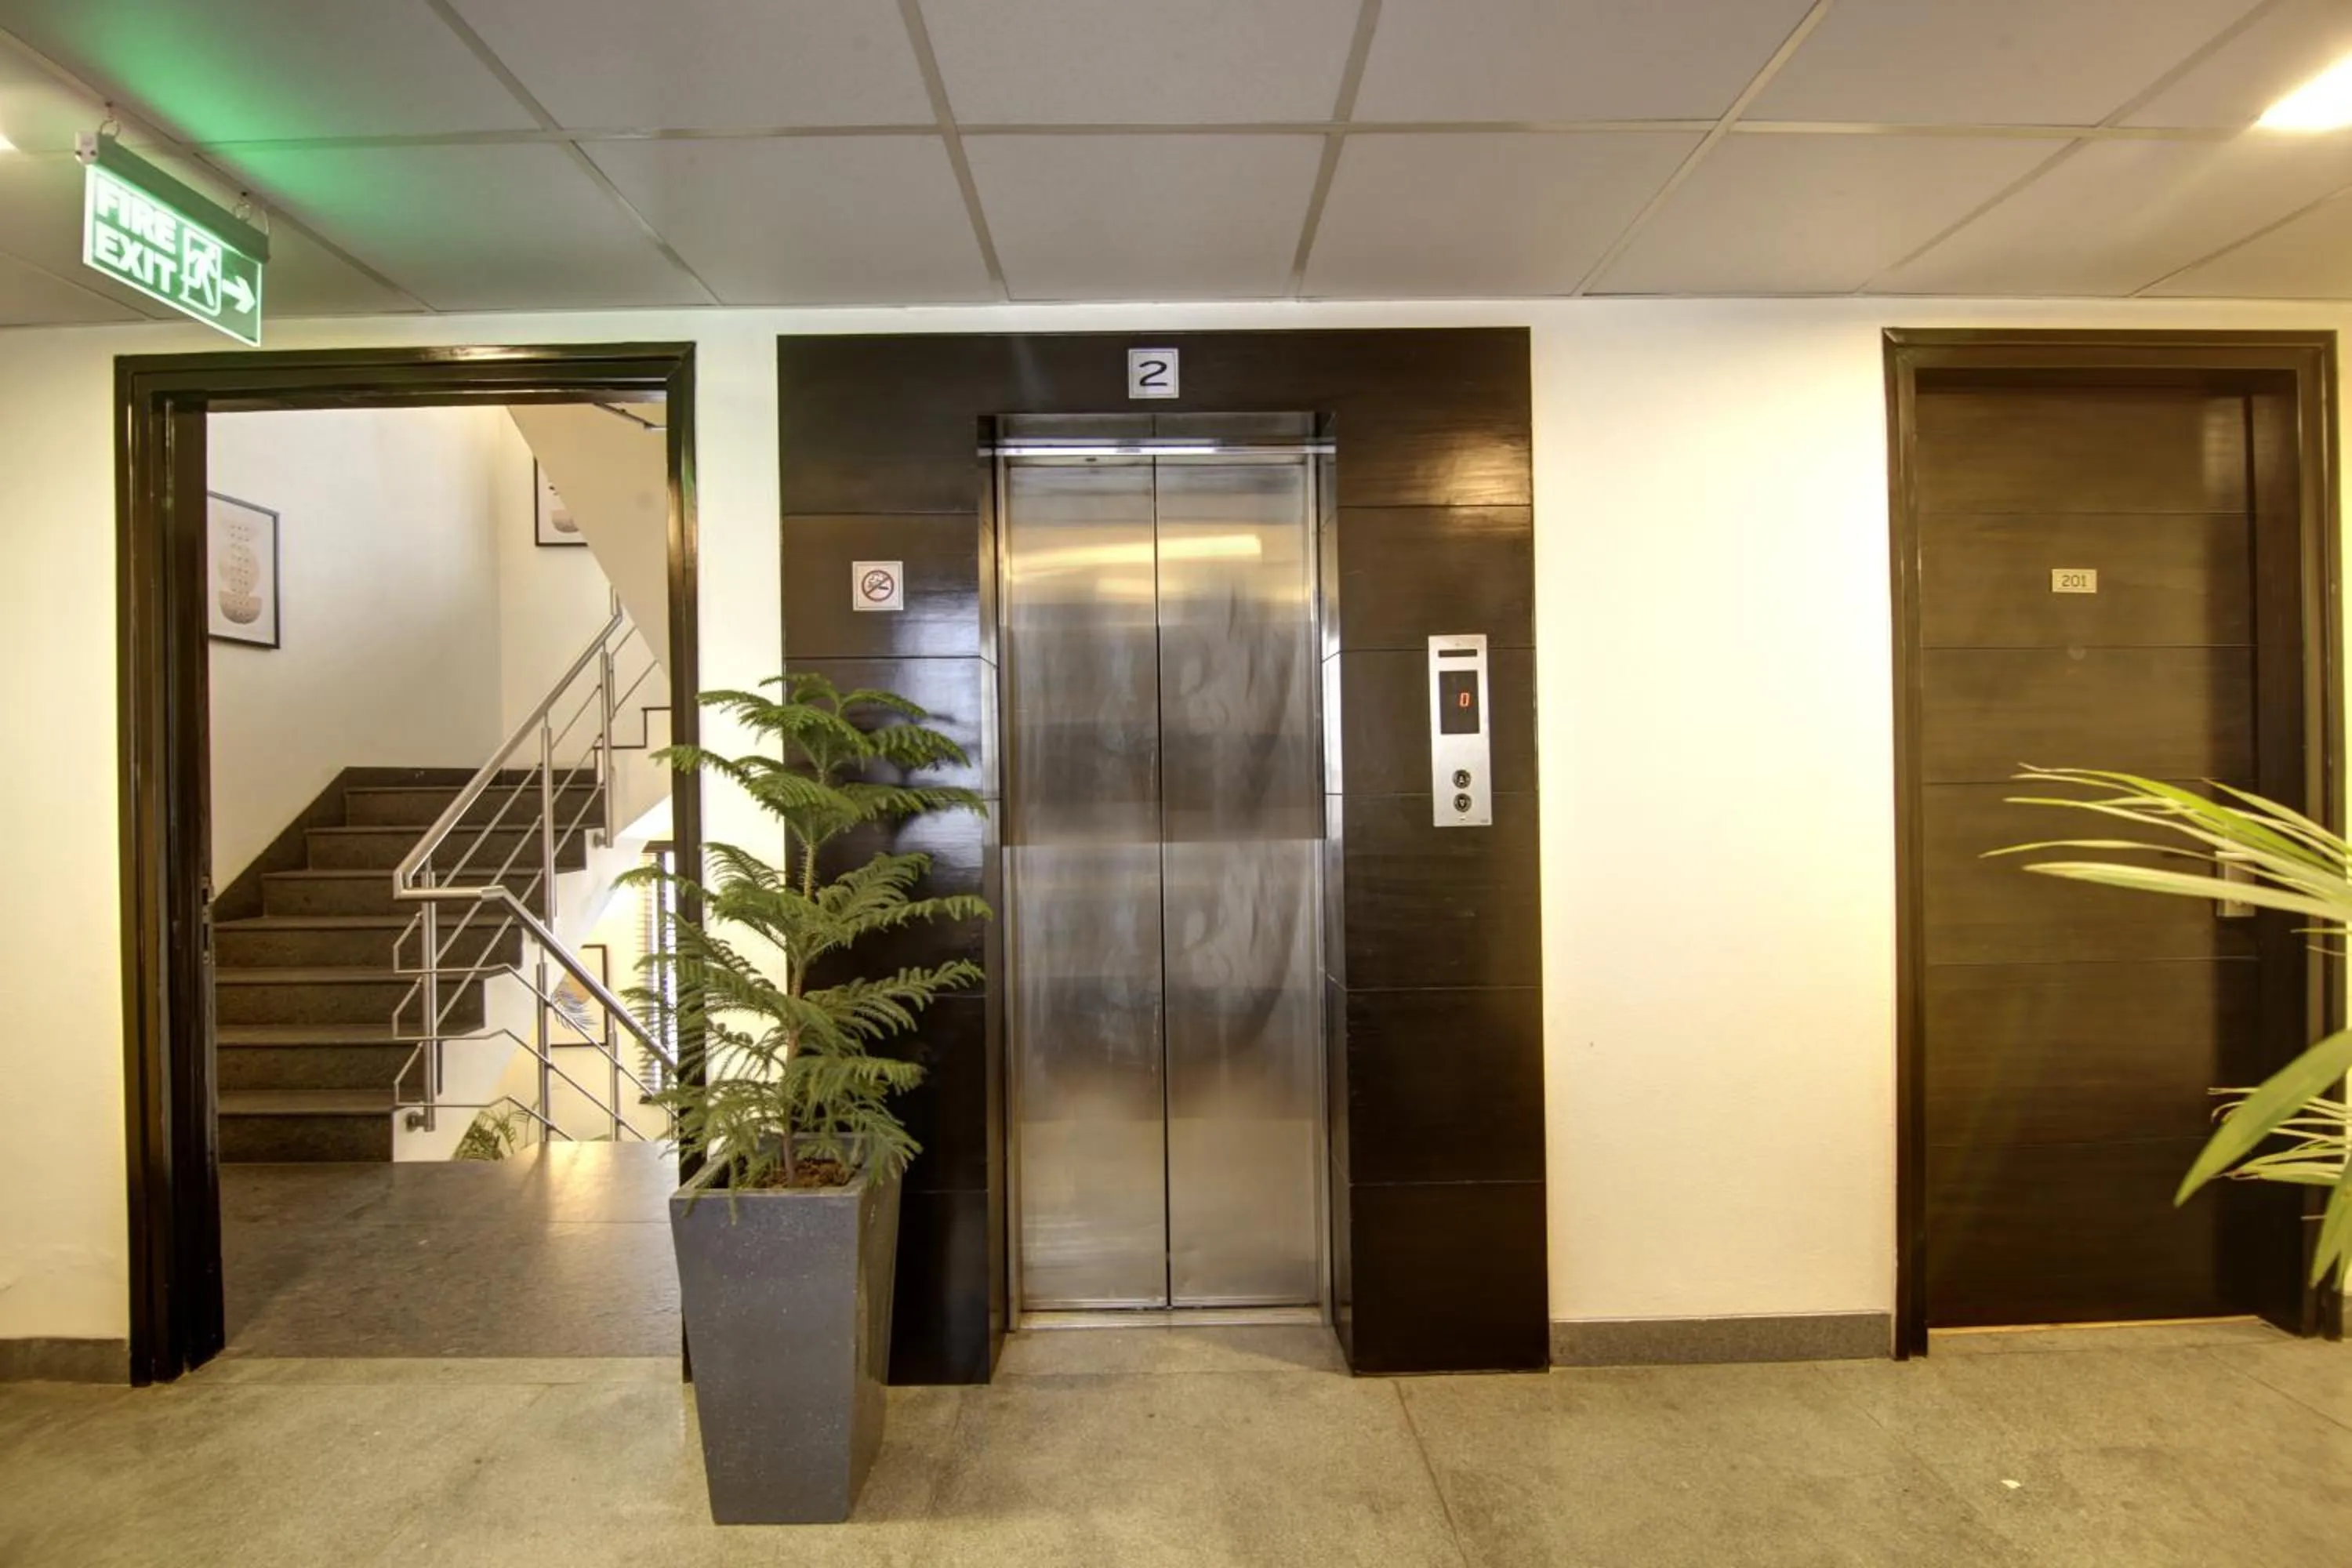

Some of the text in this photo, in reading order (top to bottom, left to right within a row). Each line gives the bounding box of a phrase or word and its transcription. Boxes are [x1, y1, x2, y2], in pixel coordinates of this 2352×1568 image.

[96, 178, 177, 255] FIRE
[94, 220, 178, 294] EXIT
[1139, 360, 1167, 387] 2
[2061, 574, 2089, 587] 201
[1459, 692, 1470, 707] 0
